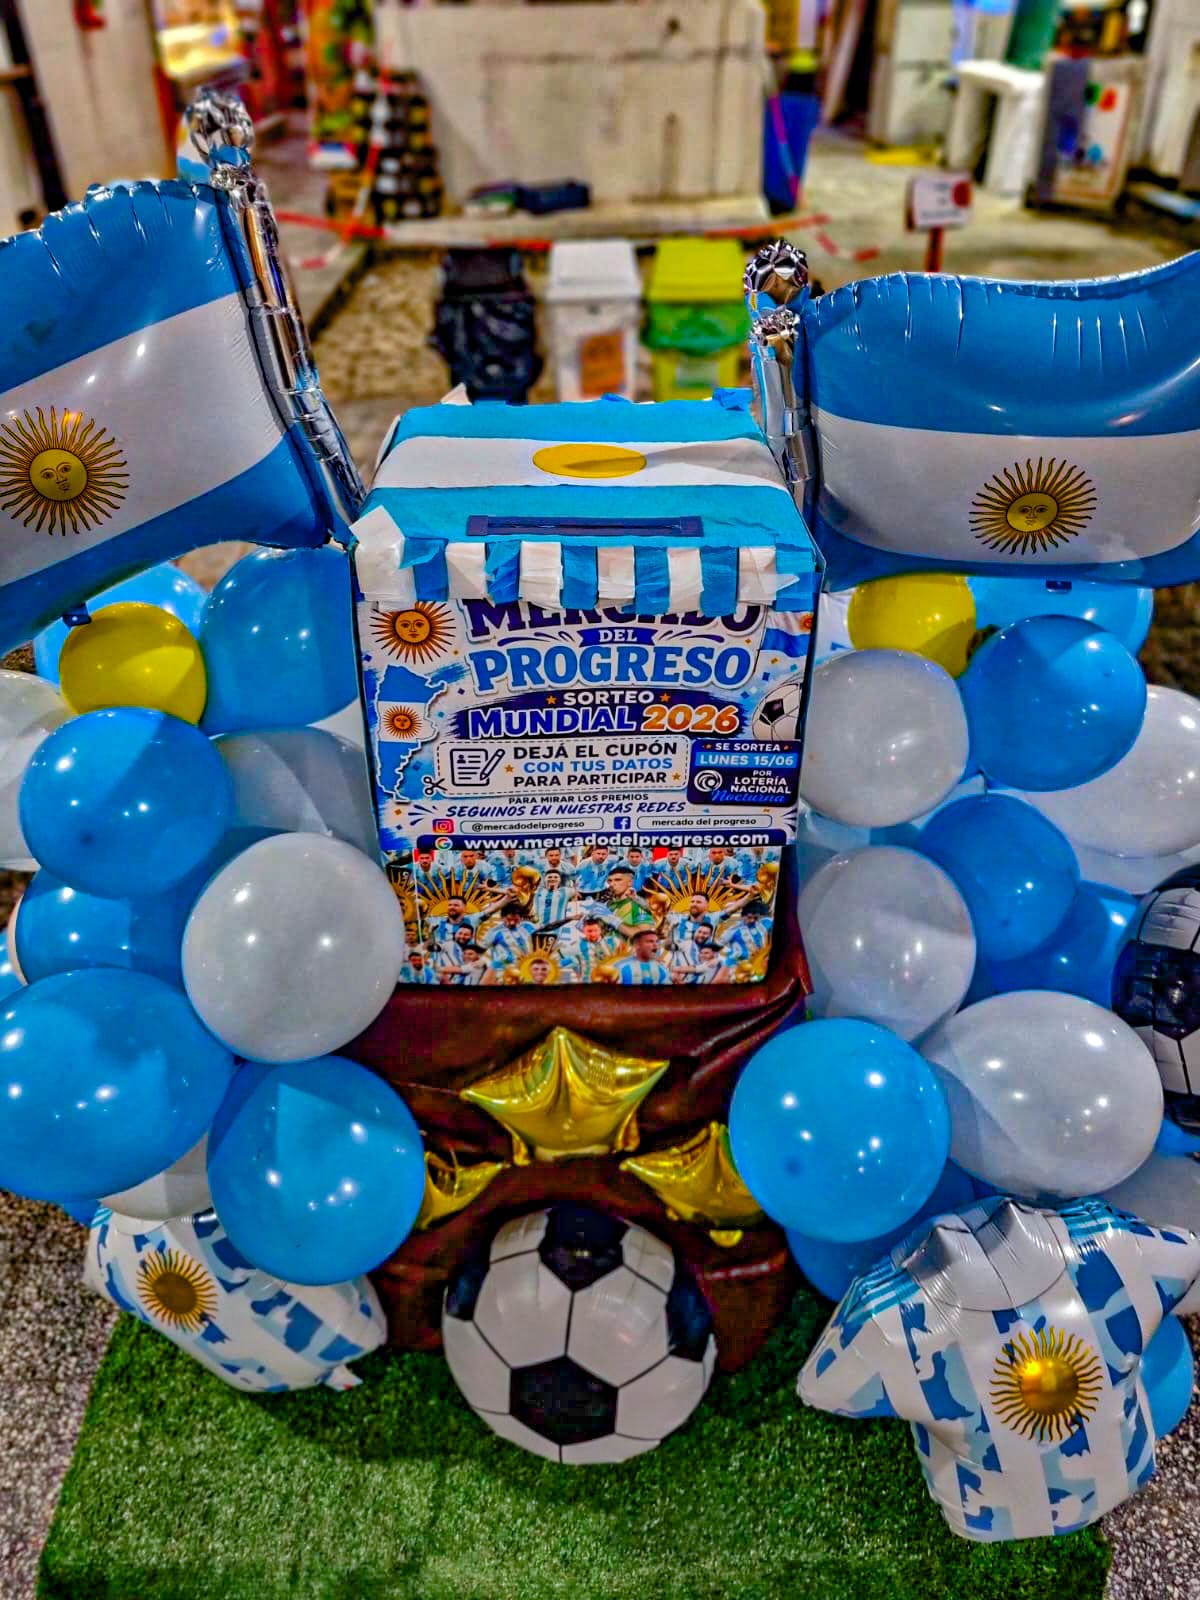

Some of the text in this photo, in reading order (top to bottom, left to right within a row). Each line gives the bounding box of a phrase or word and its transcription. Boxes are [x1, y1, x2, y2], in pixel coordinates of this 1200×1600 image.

[598, 629, 638, 642] DEL
[469, 645, 752, 691] PROGRESO
[563, 690, 655, 705] SORTEO
[468, 704, 740, 739] MUNDIAL 2026
[513, 740, 677, 759] DEJÁ EL CUPÓN
[714, 742, 781, 752] SE SORTEA
[523, 758, 673, 773] CON TUS DATOS
[700, 754, 794, 767] LUNES 15/06
[513, 772, 667, 787] PARA PARTICIPAR
[734, 776, 787, 786] LOTERÍA
[730, 785, 792, 794] NACIONAL
[509, 797, 537, 805] PARA
[540, 796, 575, 804] MIRAR
[601, 793, 649, 802] PREMIOS
[446, 801, 686, 818] SEGUINOS EN NUESTRAS REDES
[471, 821, 585, 833] @mercadodelprogreso
[652, 818, 757, 827] mercado del progreso
[464, 832, 770, 850] www.mercadodelprogreso.com
